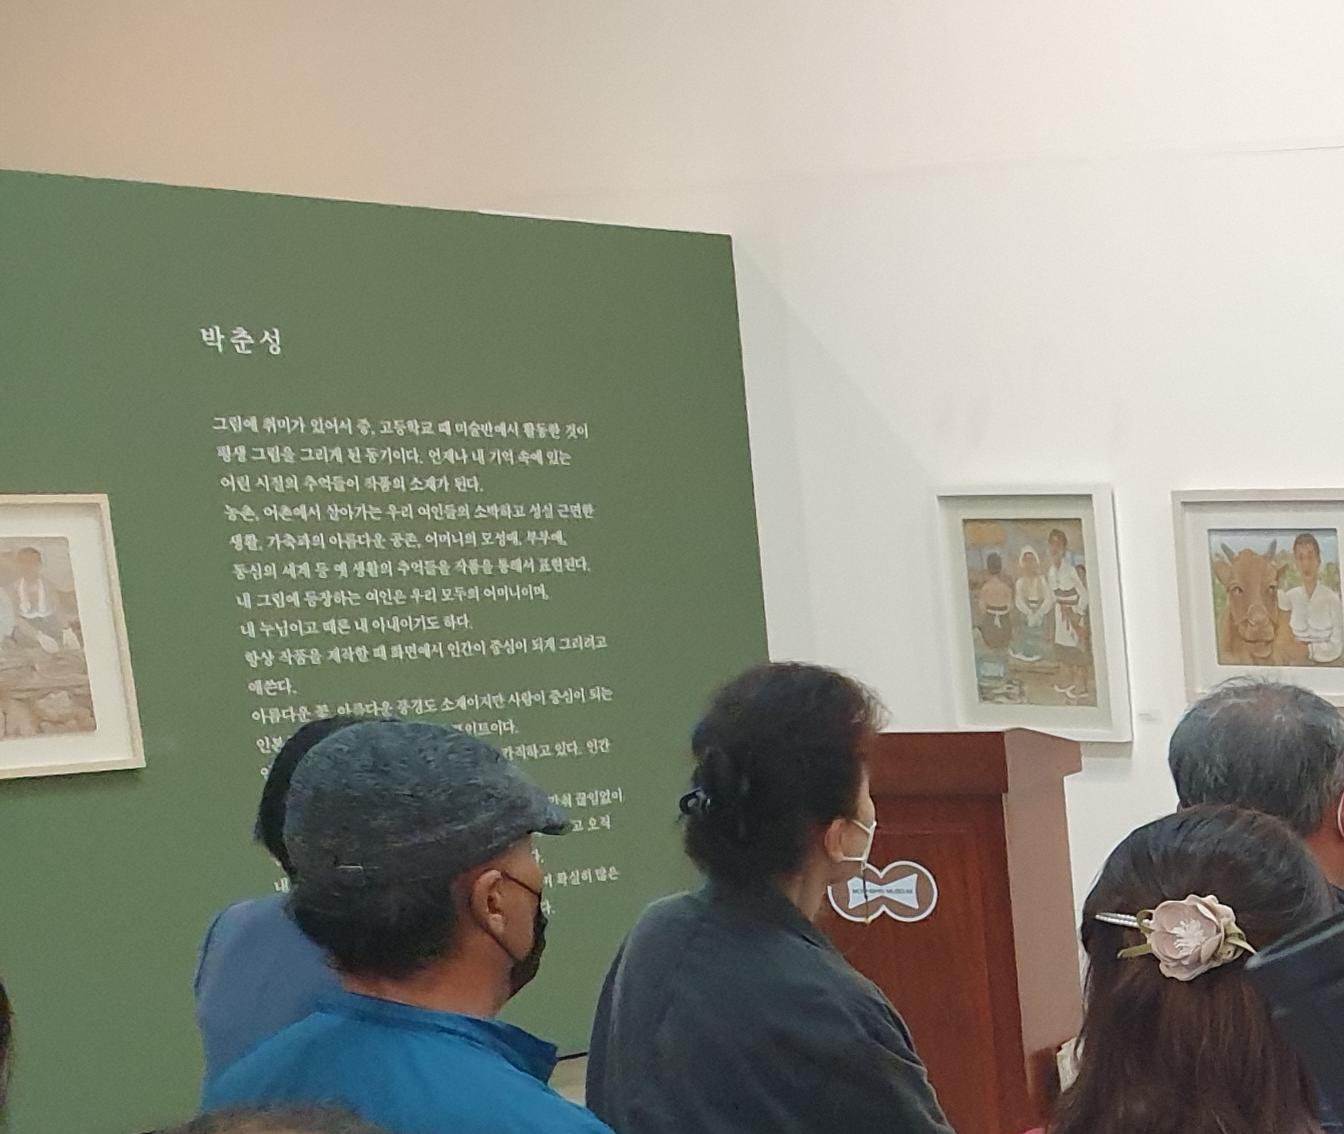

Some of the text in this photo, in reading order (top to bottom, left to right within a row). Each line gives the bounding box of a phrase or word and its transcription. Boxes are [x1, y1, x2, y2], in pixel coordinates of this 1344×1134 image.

[212, 416, 258, 432] 그림에
[263, 416, 305, 434] 취미가
[310, 417, 352, 435] 있어서
[380, 419, 435, 436] 고등학교
[438, 420, 451, 435] 때
[455, 420, 519, 438] 미술반에서
[523, 422, 560, 439] 활동한
[565, 423, 589, 439] 것이
[217, 445, 247, 462] 평생
[251, 445, 296, 463] 그림을
[301, 446, 343, 463] 그리게
[365, 447, 423, 464] 동기이다.
[428, 448, 467, 464] 언제나
[472, 449, 485, 464] 내
[489, 449, 514, 464] 기억
[518, 449, 543, 465] 속에
[546, 449, 572, 465] 있는
[221, 475, 484, 492] 어린 시절의 추억들이 작품의 소재가 된다.
[263, 503, 320, 521] 어촌에서
[327, 503, 382, 521] 살아가는
[386, 503, 413, 520] 우리
[418, 503, 470, 520] 여인들의
[474, 503, 526, 520] 소박하고
[529, 503, 554, 519] 성실
[557, 503, 595, 519] 근면한
[267, 533, 325, 550] 가족과의
[329, 532, 386, 550] 아름다운
[425, 530, 477, 548] 어머니의
[233, 562, 277, 580] 동심의
[283, 562, 311, 580] 세계
[315, 562, 330, 578] 등
[352, 560, 393, 578] 생활의
[236, 591, 251, 609] 내
[256, 590, 300, 608] 그림에
[304, 590, 361, 607] 등장하는
[366, 588, 407, 605] 여인은
[410, 587, 437, 604] 우리
[441, 585, 479, 603] 모두의
[240, 621, 255, 638] 내
[259, 619, 320, 638] 누님이고
[322, 618, 351, 635] 때론
[354, 617, 368, 633] 내
[372, 615, 440, 633] 아내이기도
[244, 650, 274, 668] 항상
[391, 642, 444, 660] 화면에서
[447, 640, 486, 658] 인간이
[489, 638, 527, 656] 중심이
[531, 636, 556, 653] 되게
[559, 634, 608, 650] 그리려고
[252, 705, 311, 724] 아름다운
[337, 701, 393, 717] 아름다운
[397, 697, 438, 715] 풍경도
[440, 692, 507, 711] 소재이지만
[508, 689, 545, 707] 사람이
[549, 687, 585, 705] 중심이
[589, 685, 613, 701] 되는
